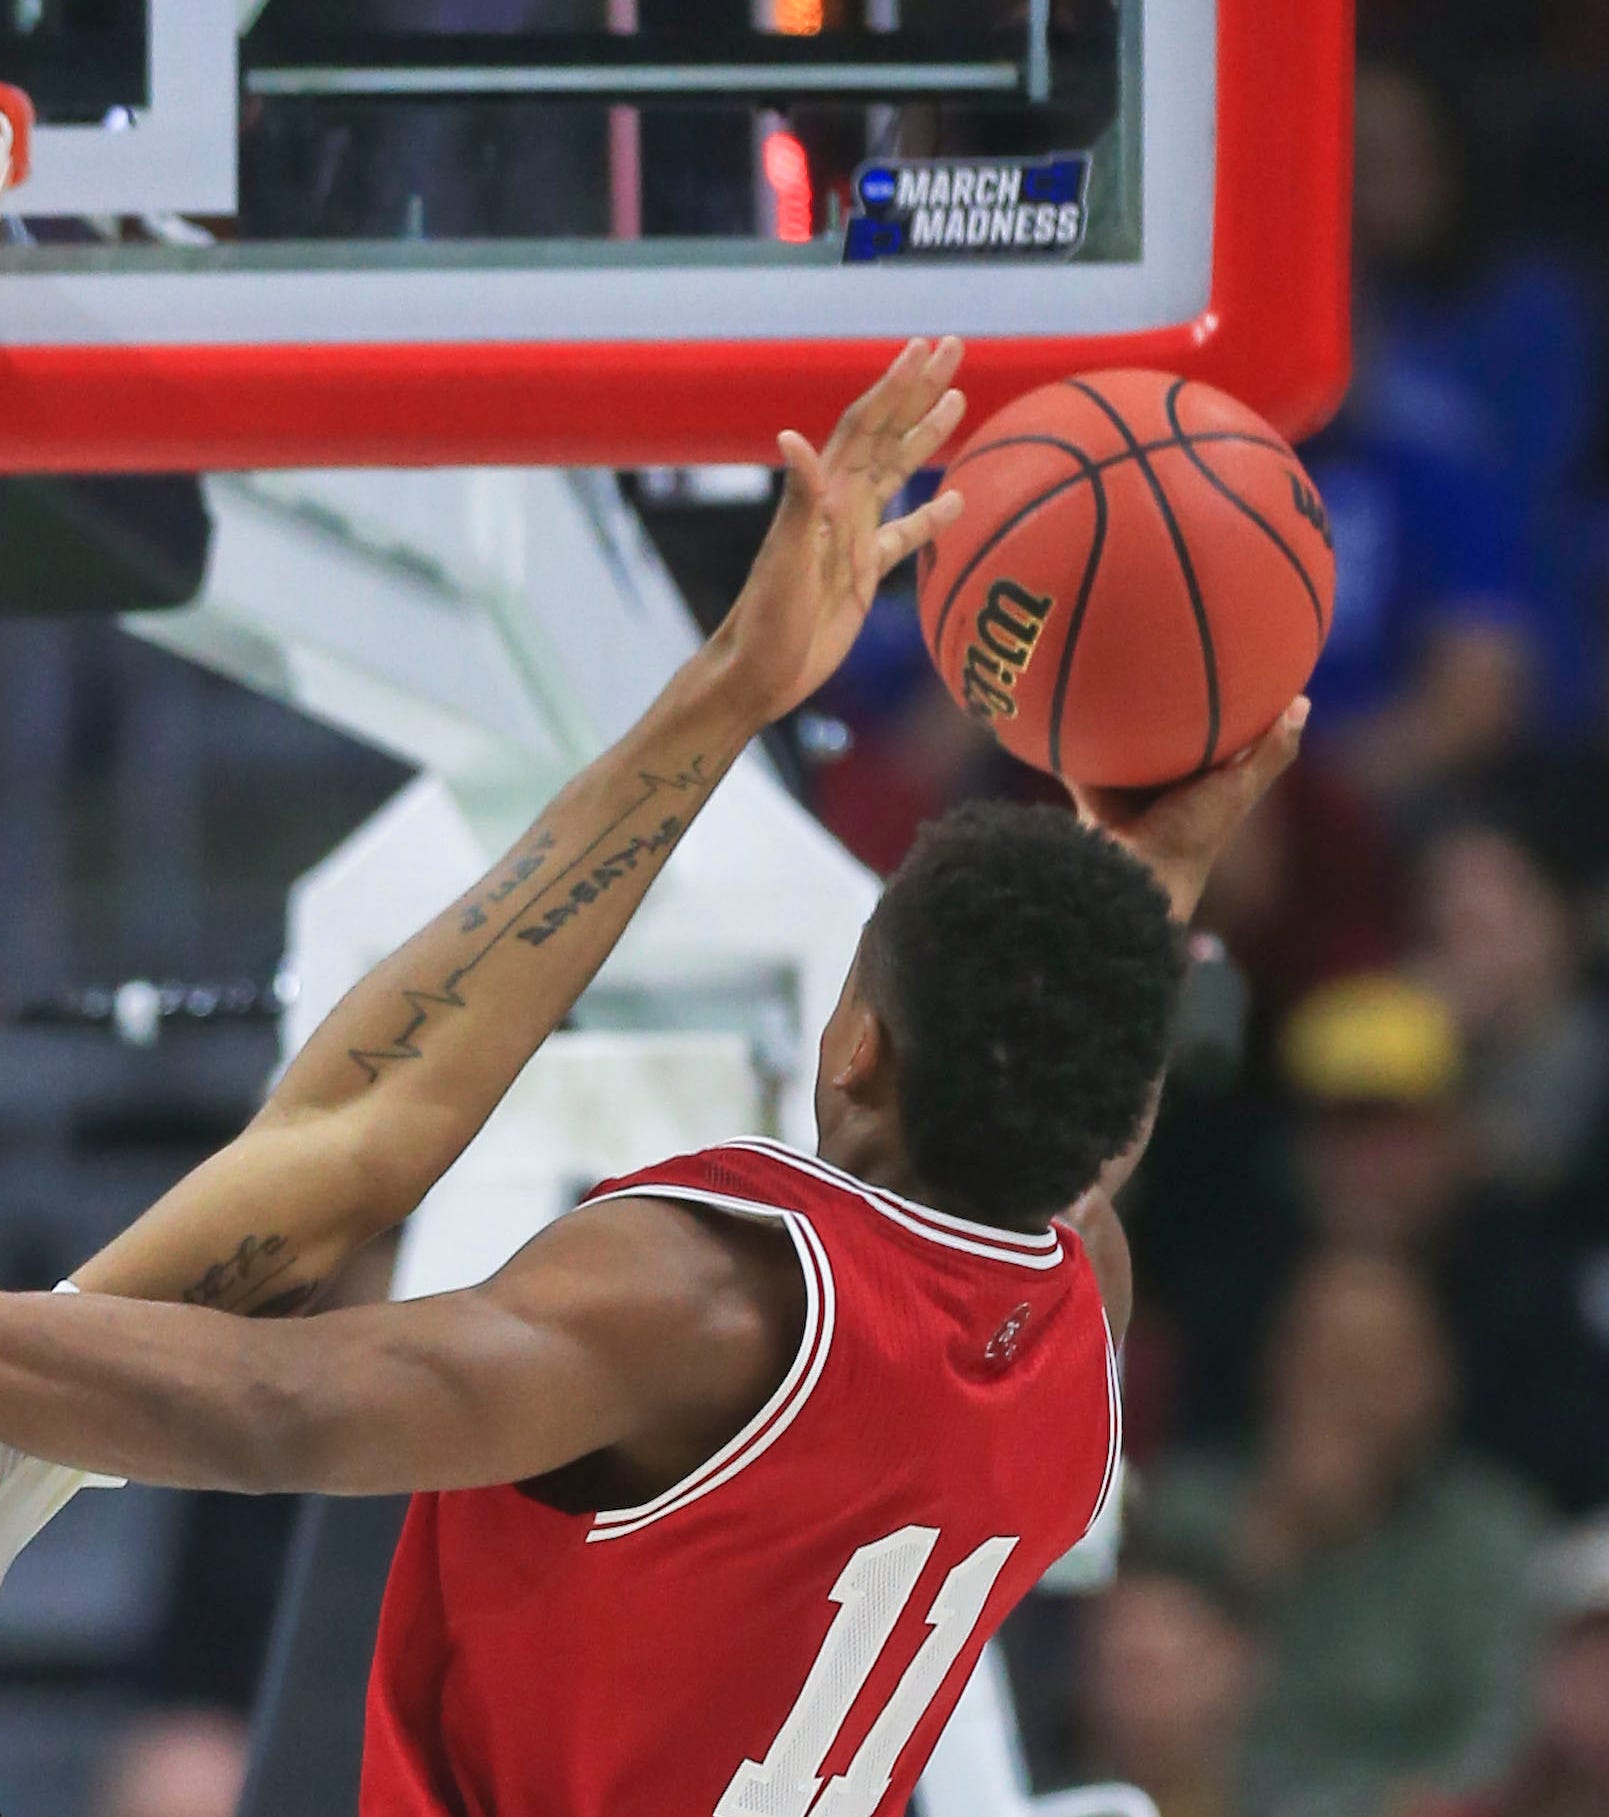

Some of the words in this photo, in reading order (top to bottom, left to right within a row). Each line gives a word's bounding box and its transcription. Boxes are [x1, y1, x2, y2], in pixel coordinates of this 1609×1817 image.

[898, 165, 1022, 210] MARCH
[911, 203, 1080, 247] MADNESS
[712, 1524, 1020, 1817] 11
